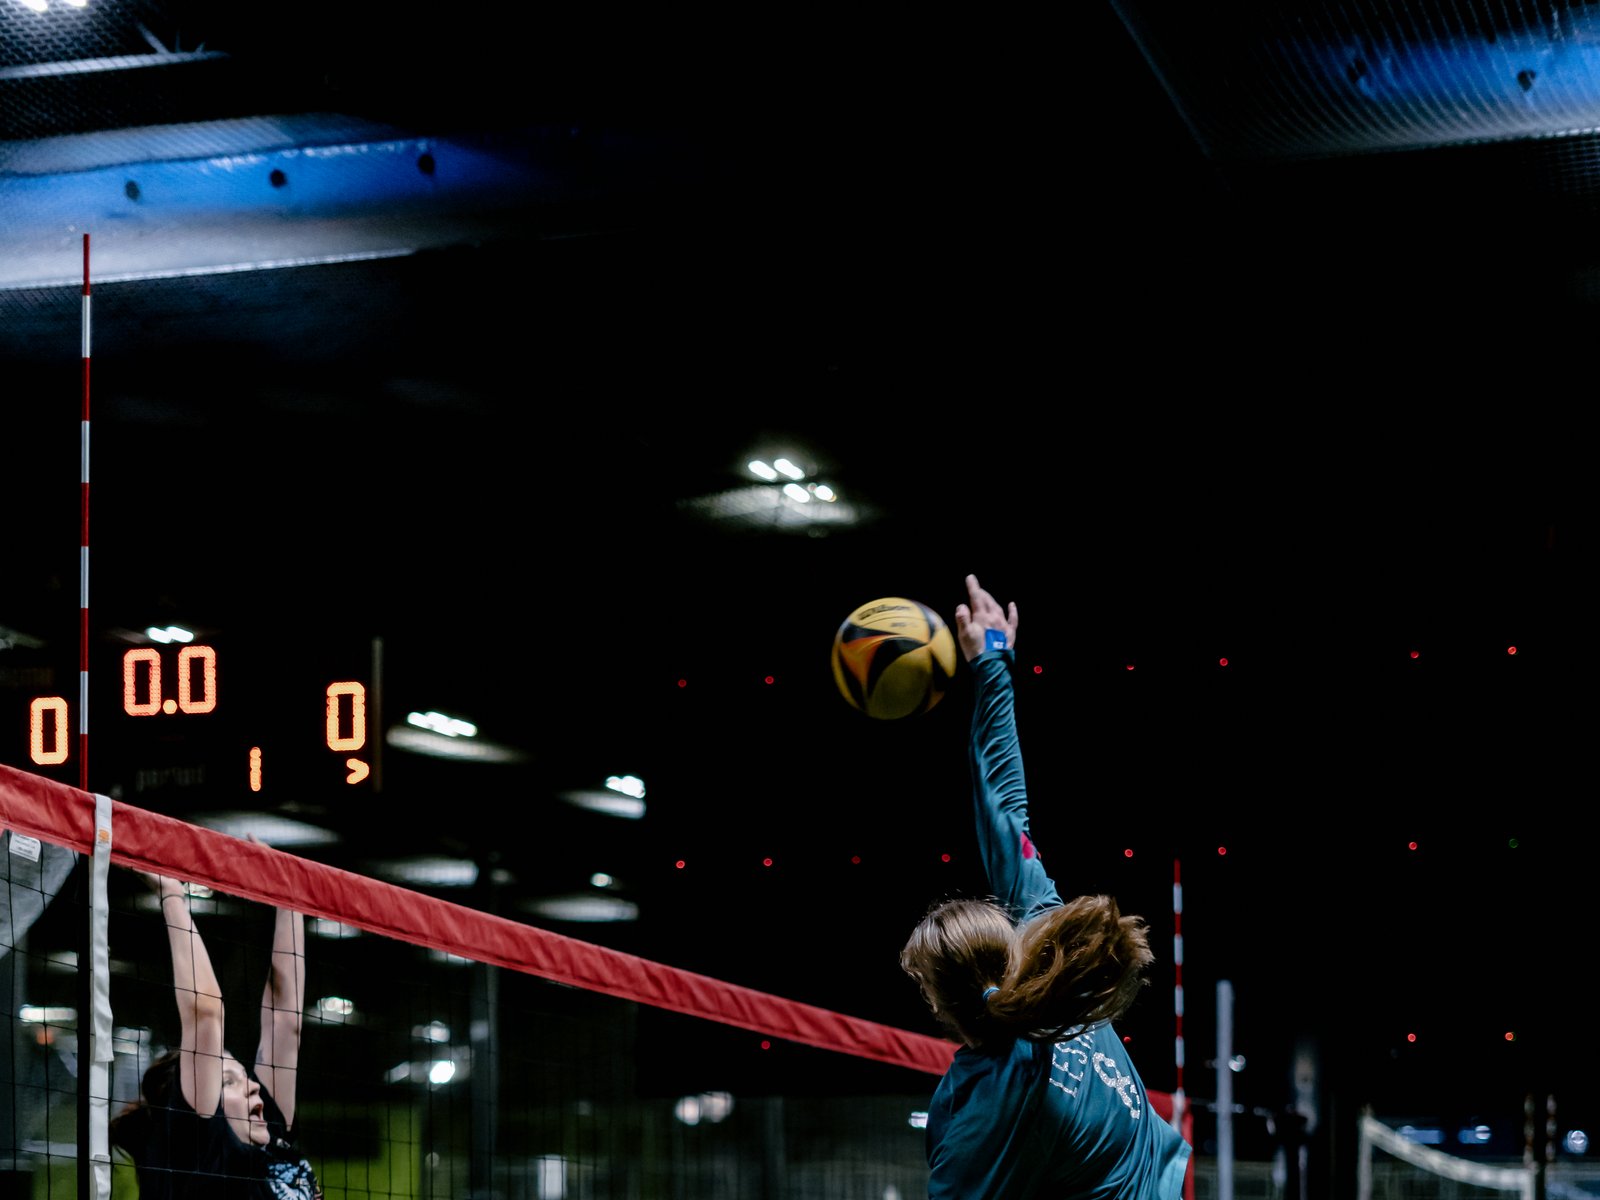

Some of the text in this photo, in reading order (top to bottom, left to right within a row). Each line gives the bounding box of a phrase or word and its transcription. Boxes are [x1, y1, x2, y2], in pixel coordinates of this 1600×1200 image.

[123, 645, 216, 716] 0.0
[30, 696, 69, 765] 0
[326, 681, 366, 752] 0
